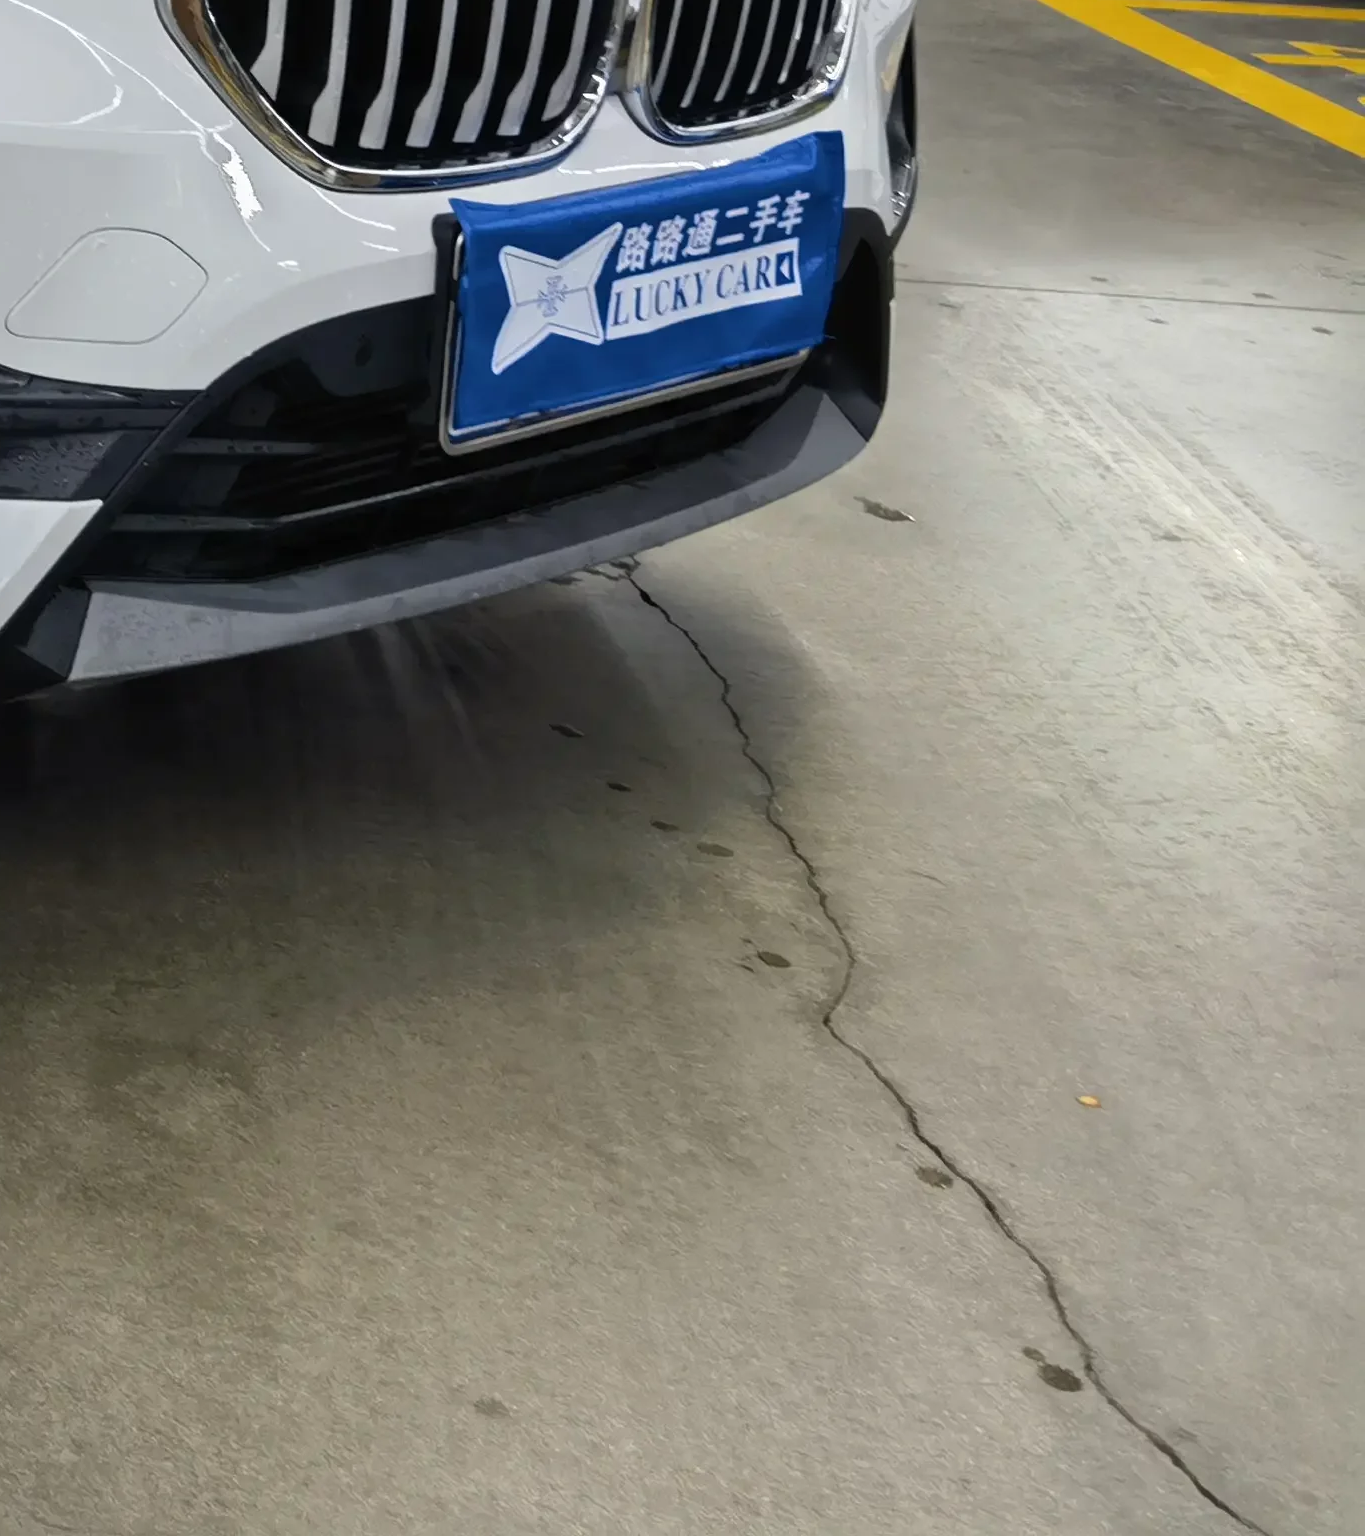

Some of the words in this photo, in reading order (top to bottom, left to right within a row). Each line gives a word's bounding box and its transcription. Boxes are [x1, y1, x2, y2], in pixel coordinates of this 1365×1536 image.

[616, 190, 810, 273] 路路通二手车
[610, 268, 712, 327] LUCKY
[716, 255, 771, 300] CAR
